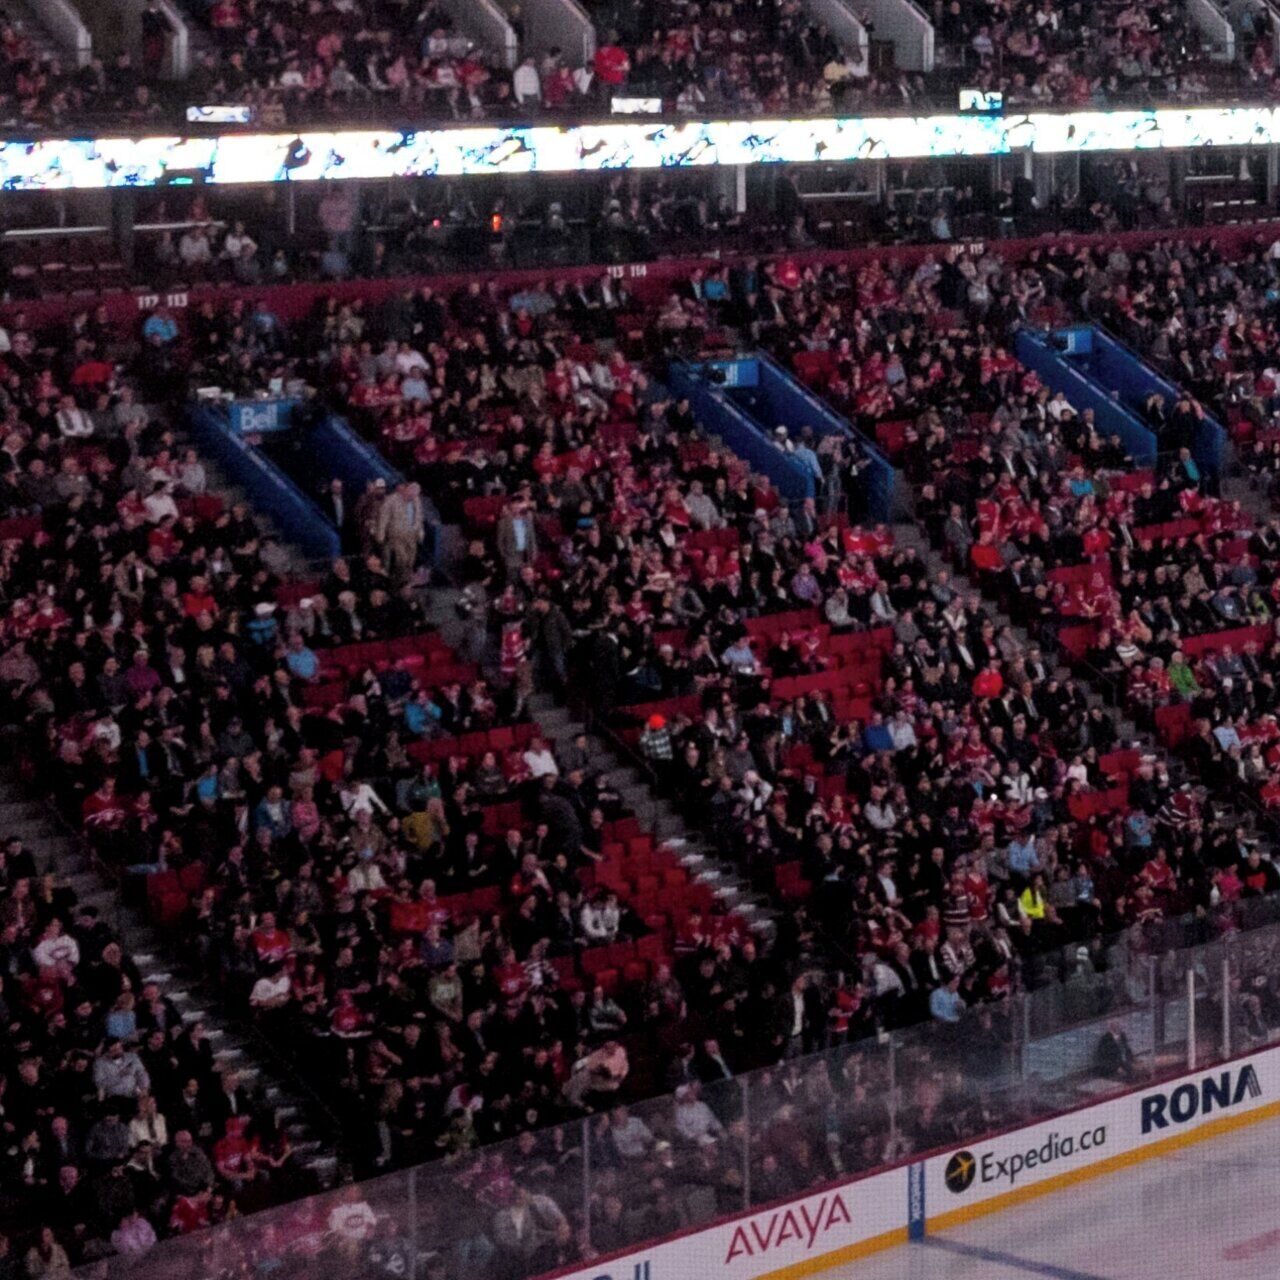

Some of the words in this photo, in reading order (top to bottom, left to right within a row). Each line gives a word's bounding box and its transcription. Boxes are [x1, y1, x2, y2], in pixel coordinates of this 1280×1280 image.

[240, 406, 278, 431] Bell
[1141, 1063, 1263, 1135] RONA
[981, 1124, 1107, 1185] Expedia.ca
[724, 1193, 852, 1265] AVAYA
